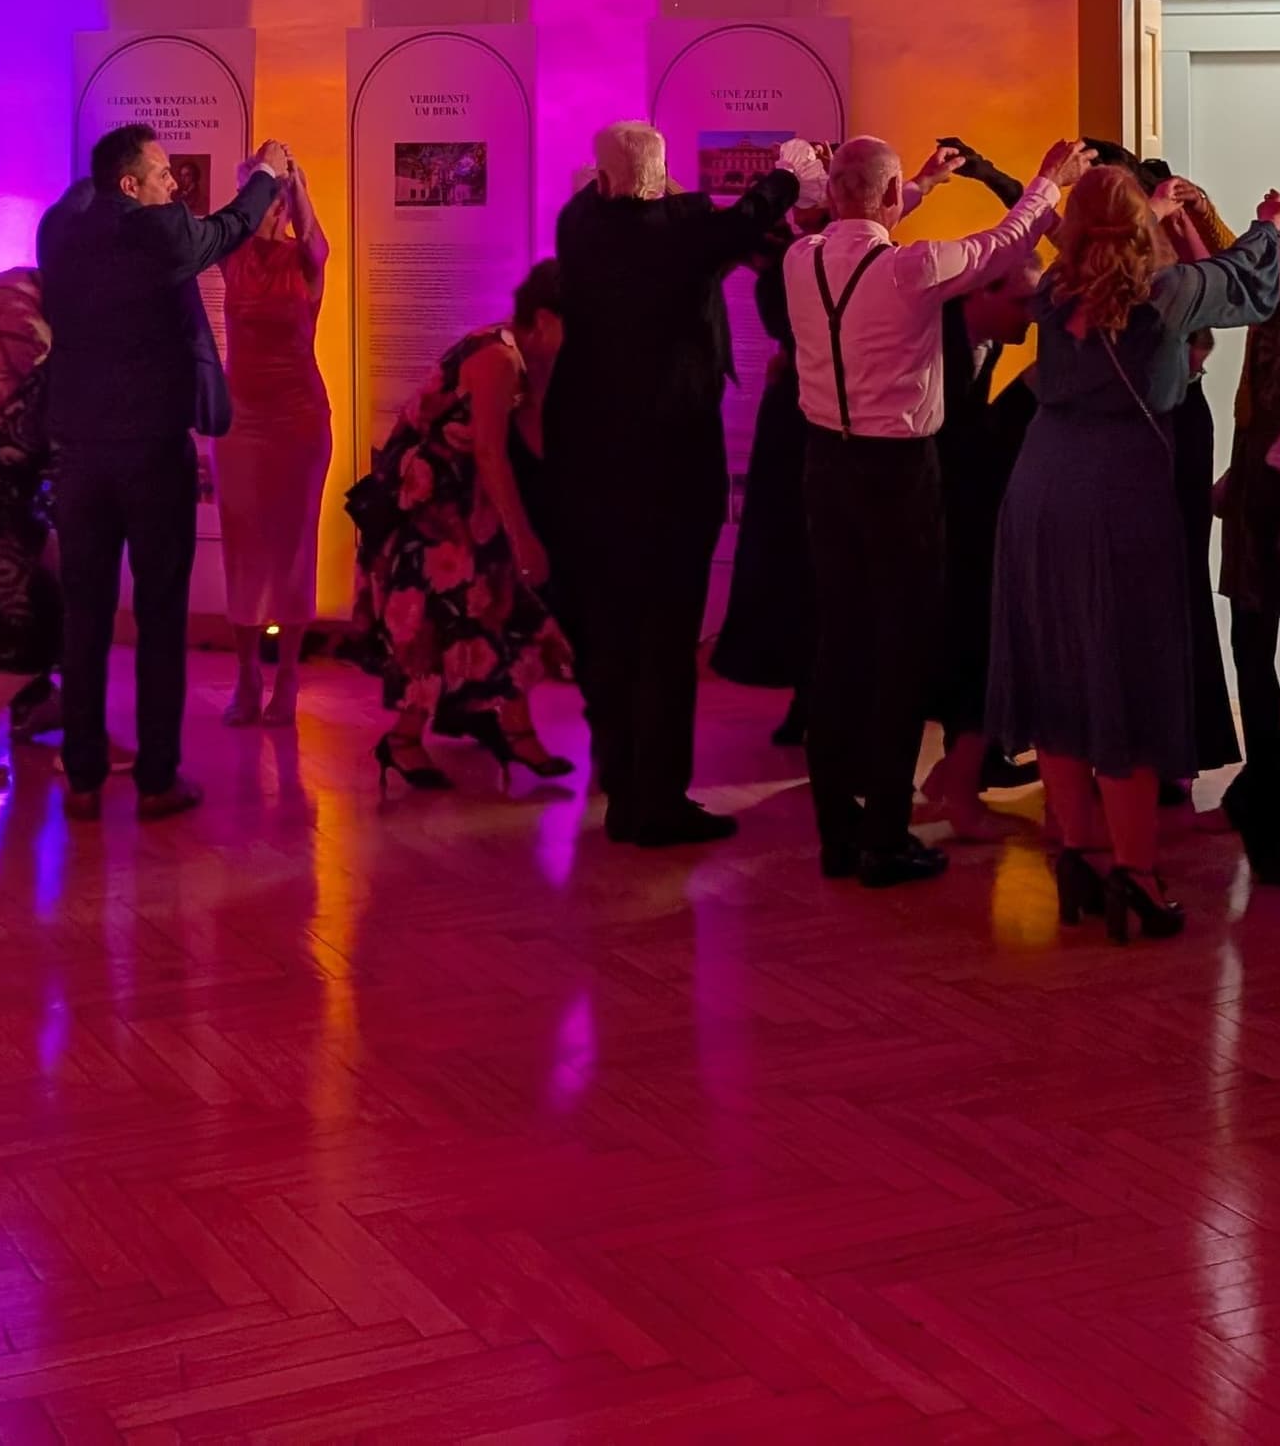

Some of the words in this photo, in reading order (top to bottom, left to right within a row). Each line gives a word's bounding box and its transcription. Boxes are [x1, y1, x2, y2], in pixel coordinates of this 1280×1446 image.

[409, 94, 471, 104] VERDIENSTE
[710, 89, 741, 99] SEINE
[744, 89, 769, 99] ZEIT
[771, 89, 784, 99] IN
[414, 106, 430, 116] UM
[432, 106, 468, 116] BERKA
[724, 102, 769, 112] WEIMAR
[134, 108, 181, 117] COUDRAY
[151, 119, 220, 128] VERGESSENER
